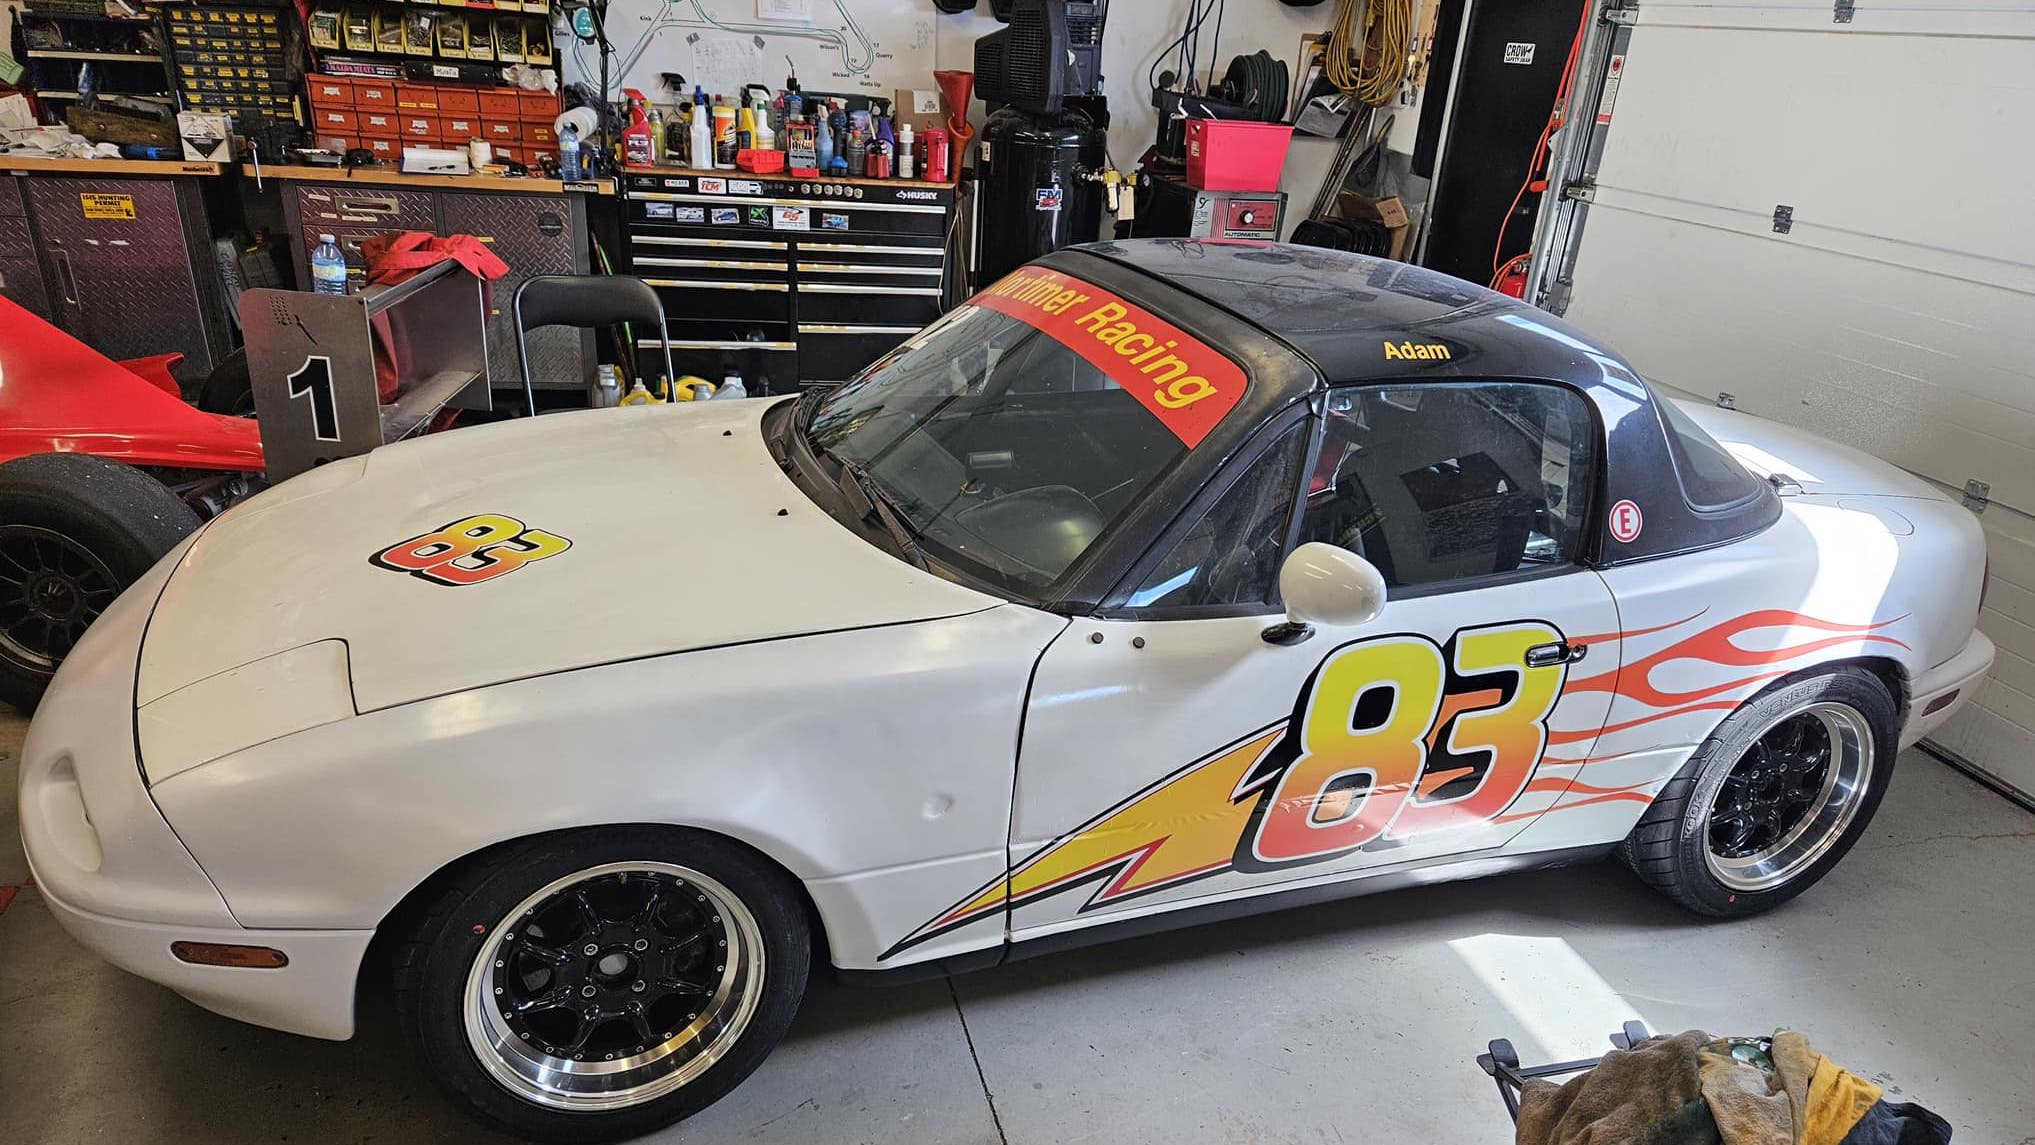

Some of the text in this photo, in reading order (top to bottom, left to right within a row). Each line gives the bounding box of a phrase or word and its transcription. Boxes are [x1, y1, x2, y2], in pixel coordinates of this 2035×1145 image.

[876, 52, 893, 60] Quarry
[1507, 44, 1528, 57] CROW
[907, 191, 938, 200] HUSKY
[1074, 301, 1218, 409] Racing
[1383, 341, 1451, 360] Adam
[287, 355, 342, 442] 1
[1619, 508, 1632, 534] E
[369, 513, 573, 587] 83
[1240, 619, 1571, 872] 83
